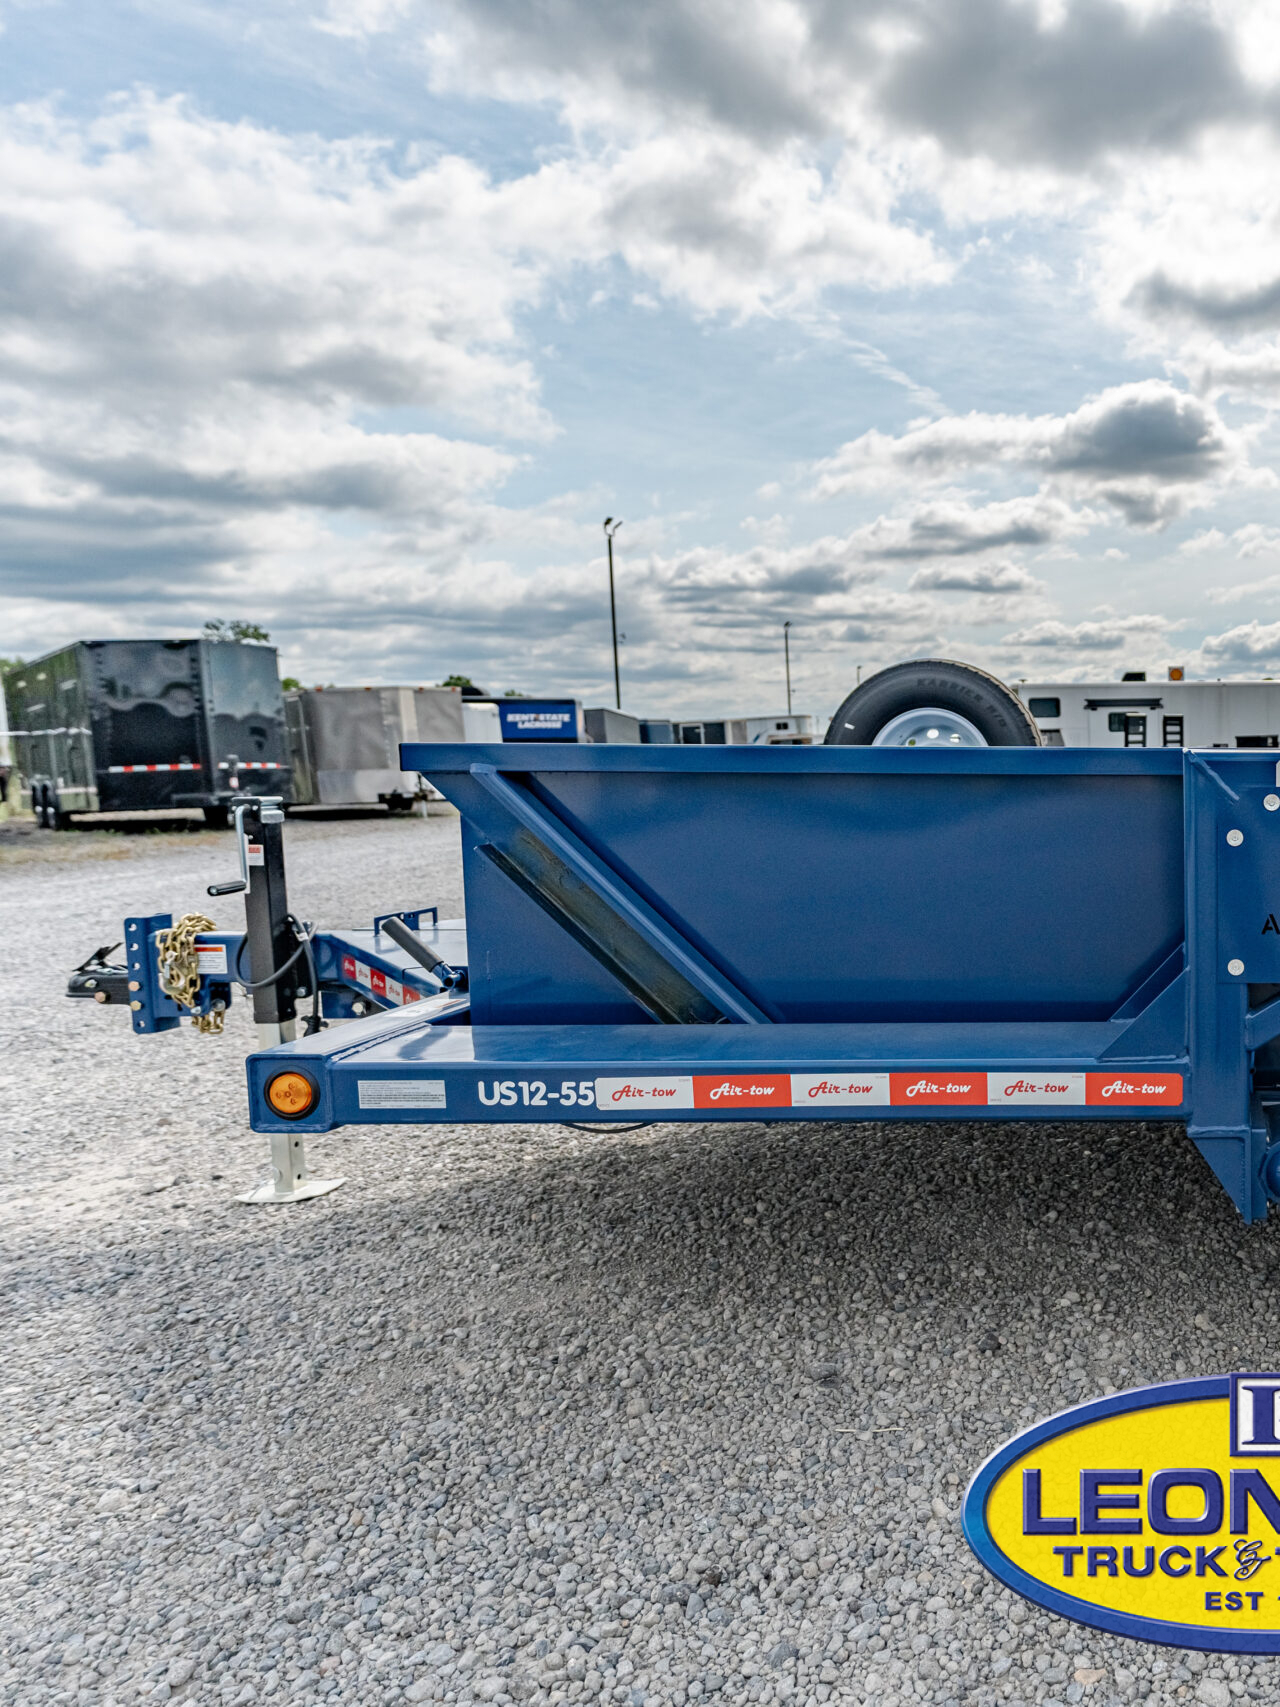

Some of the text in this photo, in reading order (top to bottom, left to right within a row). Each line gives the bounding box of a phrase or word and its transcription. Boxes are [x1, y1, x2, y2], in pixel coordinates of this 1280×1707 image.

[477, 1080, 596, 1106] US12-55
[611, 1083, 677, 1101] Air-tow
[709, 1082, 776, 1100] Air-tow
[807, 1081, 873, 1099] Air-tow
[906, 1080, 972, 1098] Air-tow
[1004, 1080, 1069, 1097] Air-tow
[1101, 1080, 1167, 1098] Air-tow
